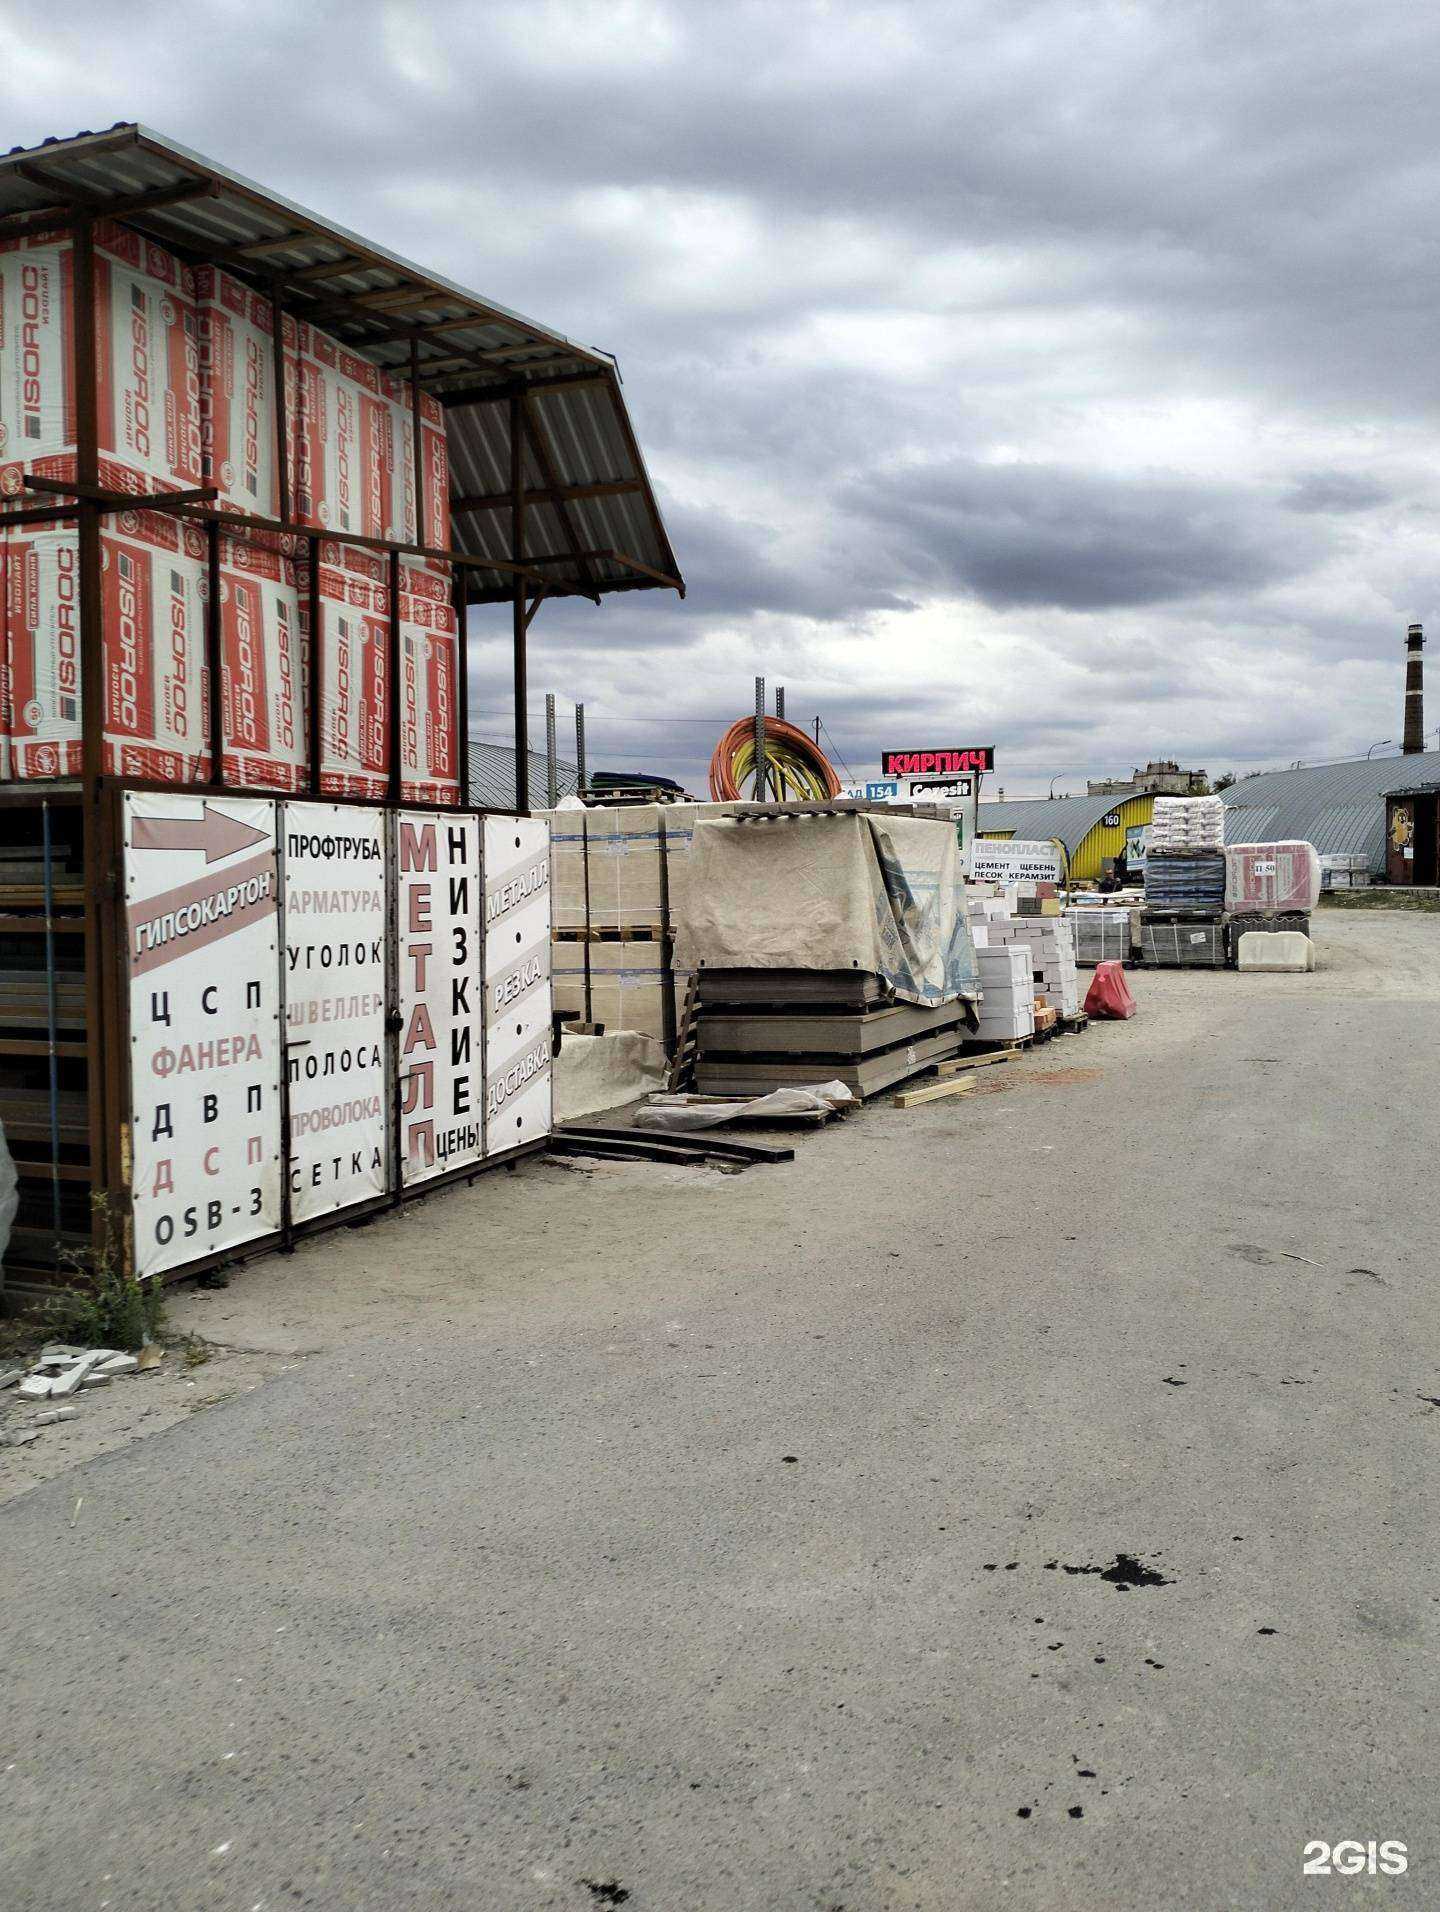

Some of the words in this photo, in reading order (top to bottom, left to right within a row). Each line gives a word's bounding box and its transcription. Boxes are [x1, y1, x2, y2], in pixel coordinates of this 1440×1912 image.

[41, 266, 50, 325] ИЗОЛАЙТ
[23, 265, 40, 412] ISOROC
[132, 307, 150, 457] ISOROC
[184, 332, 201, 478] ISOROC
[246, 340, 257, 472] ISOROC
[337, 387, 349, 509] ISOROC
[30, 556, 38, 593] КАМНЯ
[30, 597, 38, 625] СИЛА
[57, 547, 75, 694] ISOROC
[119, 580, 137, 728] ISOROC
[171, 595, 187, 738] ISOROC
[236, 608, 255, 742] ISOROC
[112, 663, 120, 723] ИЗОЛАЙТ
[164, 675, 172, 732] ИЗОЛАЙТ
[278, 622, 294, 749] ISOROC
[337, 638, 350, 760] ISOROC
[373, 648, 384, 766] ISOROC
[405, 656, 417, 769] ISOROC
[436, 663, 448, 773] ISOROC
[888, 751, 986, 773] КИРПИЧ
[870, 787, 893, 799] 154
[1105, 815, 1119, 825] 160
[288, 834, 381, 860] ПРОФТРУБА
[975, 862, 1010, 870] ЦЕМЕНТ
[1020, 864, 1056, 872] ЩЕБЕНЬ
[288, 890, 381, 914] АРМАТУРА
[487, 858, 549, 923] МЕТАЛЛ
[1009, 873, 1056, 881] КЕРАМЗИТ
[135, 871, 271, 955] ГИПСОКАРТОН
[287, 941, 381, 970] УГОЛОК
[448, 826, 471, 1116] НИЗКИЕ
[495, 955, 541, 1013] РЕЗКА
[152, 981, 260, 1026] ЦСП
[288, 994, 382, 1026] ШВЕЛЛЕР
[152, 1033, 262, 1078] ФАНЕРА
[288, 1045, 382, 1083] ПОЛОСА
[487, 1040, 549, 1120] ДОСТАВКА
[152, 1084, 262, 1142] ДВП
[290, 1096, 382, 1138] ПРОВОЛОКА
[437, 1123, 479, 1162] ЦЕНЫ
[152, 1136, 262, 1198] ДСП
[290, 1147, 382, 1193] СЕТКА
[156, 1187, 262, 1246] OSB-3
